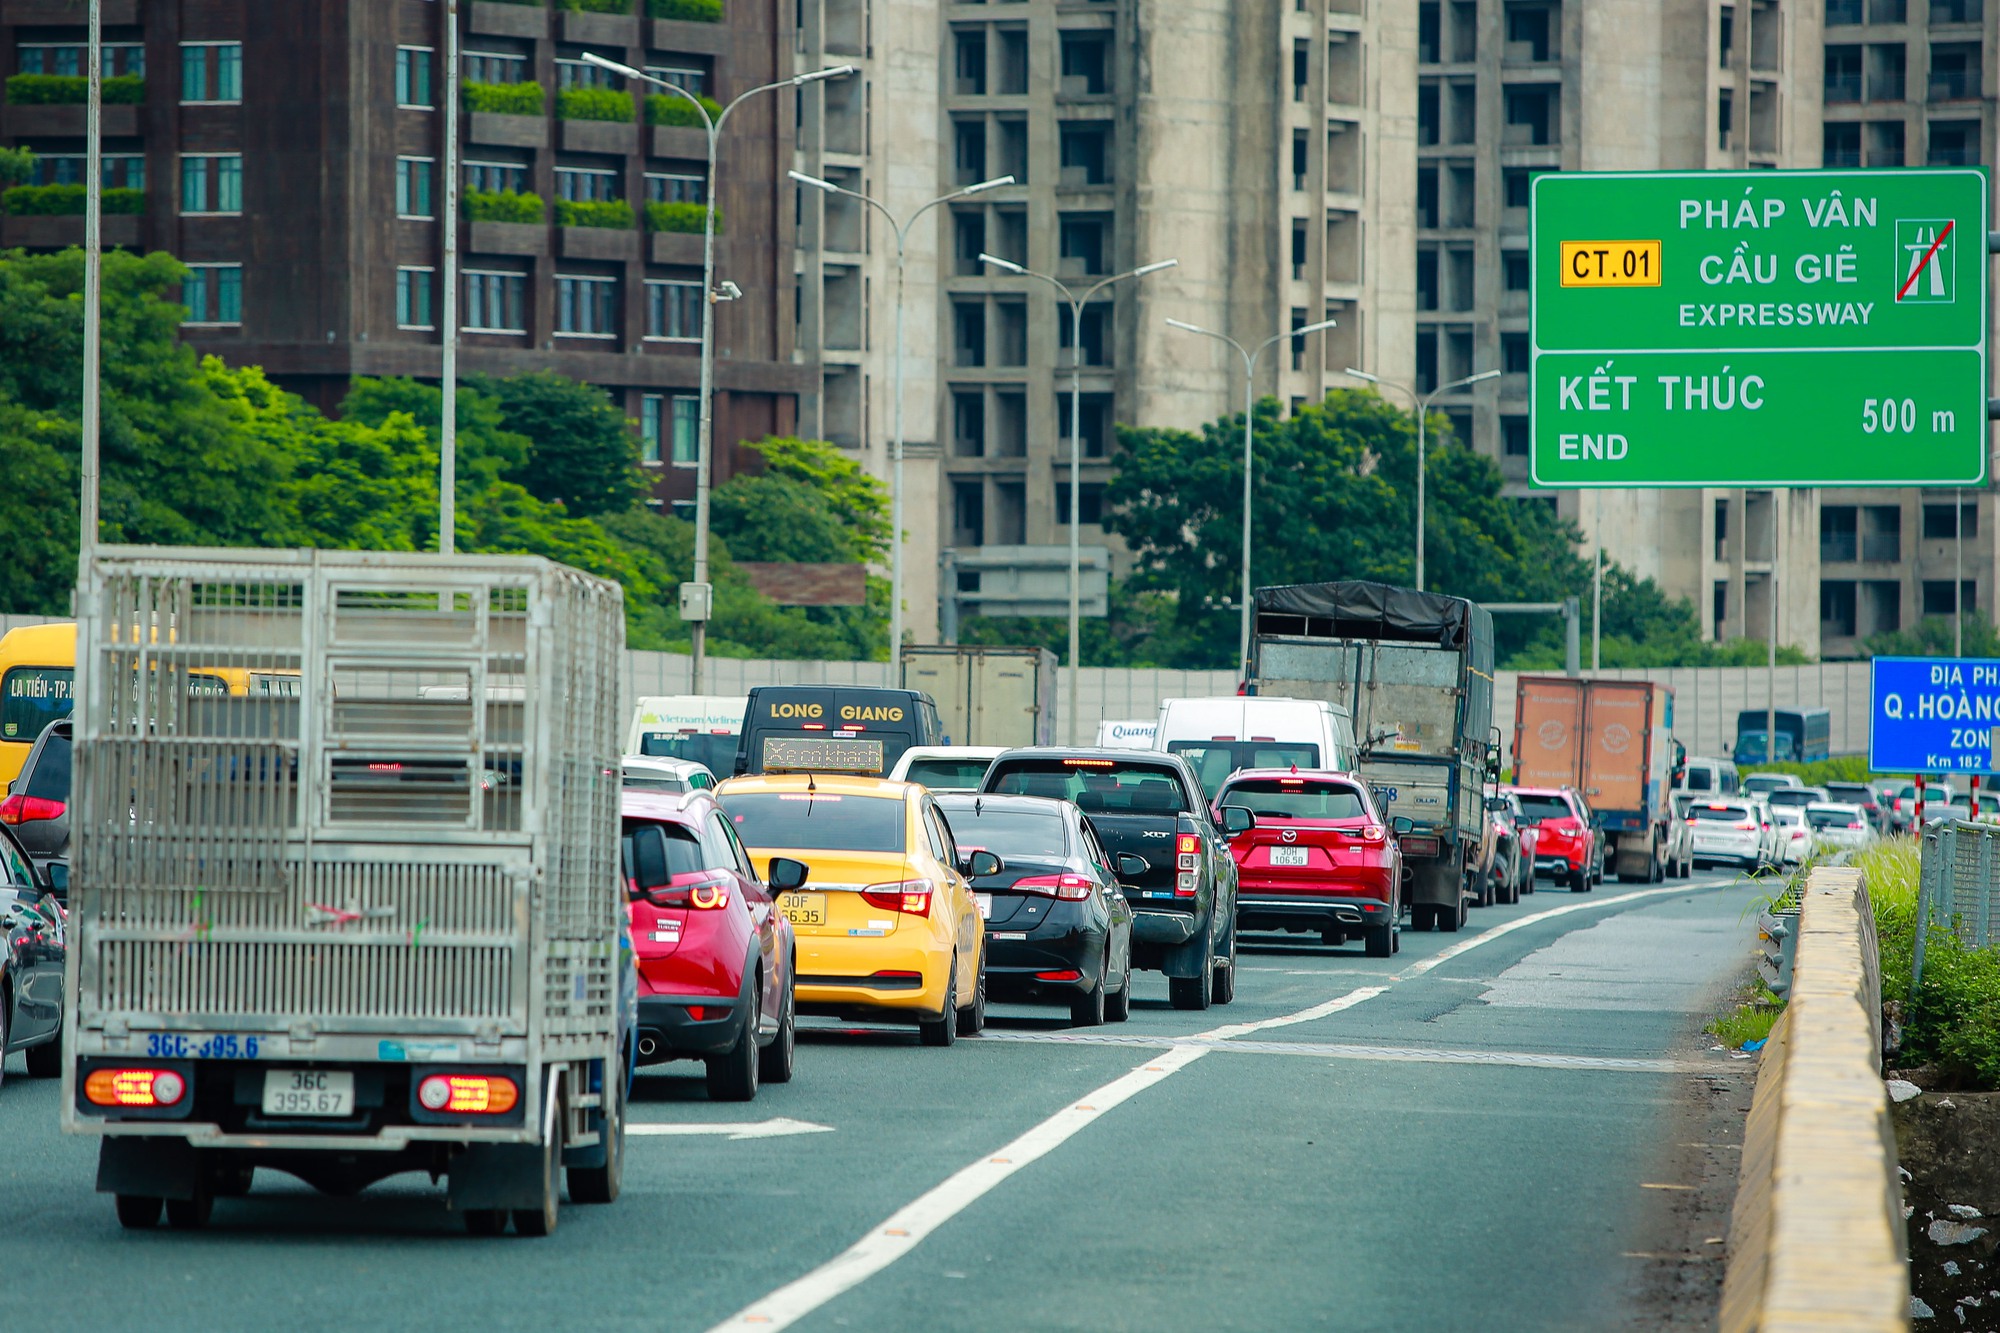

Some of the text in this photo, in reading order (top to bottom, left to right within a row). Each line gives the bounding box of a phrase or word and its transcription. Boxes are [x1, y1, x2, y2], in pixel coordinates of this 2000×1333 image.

[1680, 187, 1878, 229] PHÁP VÂN
[1572, 250, 1650, 279] CT.01
[1700, 241, 1858, 284] CẦU GIẼ
[1680, 302, 1874, 326] EXPRESSWAY
[1559, 361, 1765, 410] KẾT THÚC
[1862, 398, 1954, 434] 500 m
[1559, 434, 1628, 461] END
[11, 679, 23, 697] LA
[26, 674, 48, 698] TIẾN
[1931, 665, 2000, 690] ĐỊA PH
[659, 714, 705, 724] Vietnam
[770, 703, 903, 722] LONG GIANG
[766, 742, 797, 764] Xe
[825, 743, 880, 766] khách
[1927, 755, 1982, 768] Km 182
[1281, 847, 1297, 856] 30H
[783, 896, 808, 908] 30F
[147, 1033, 266, 1058] 36C-395.6
[291, 1073, 328, 1091] 36C
[274, 1094, 343, 1113] 395.67
